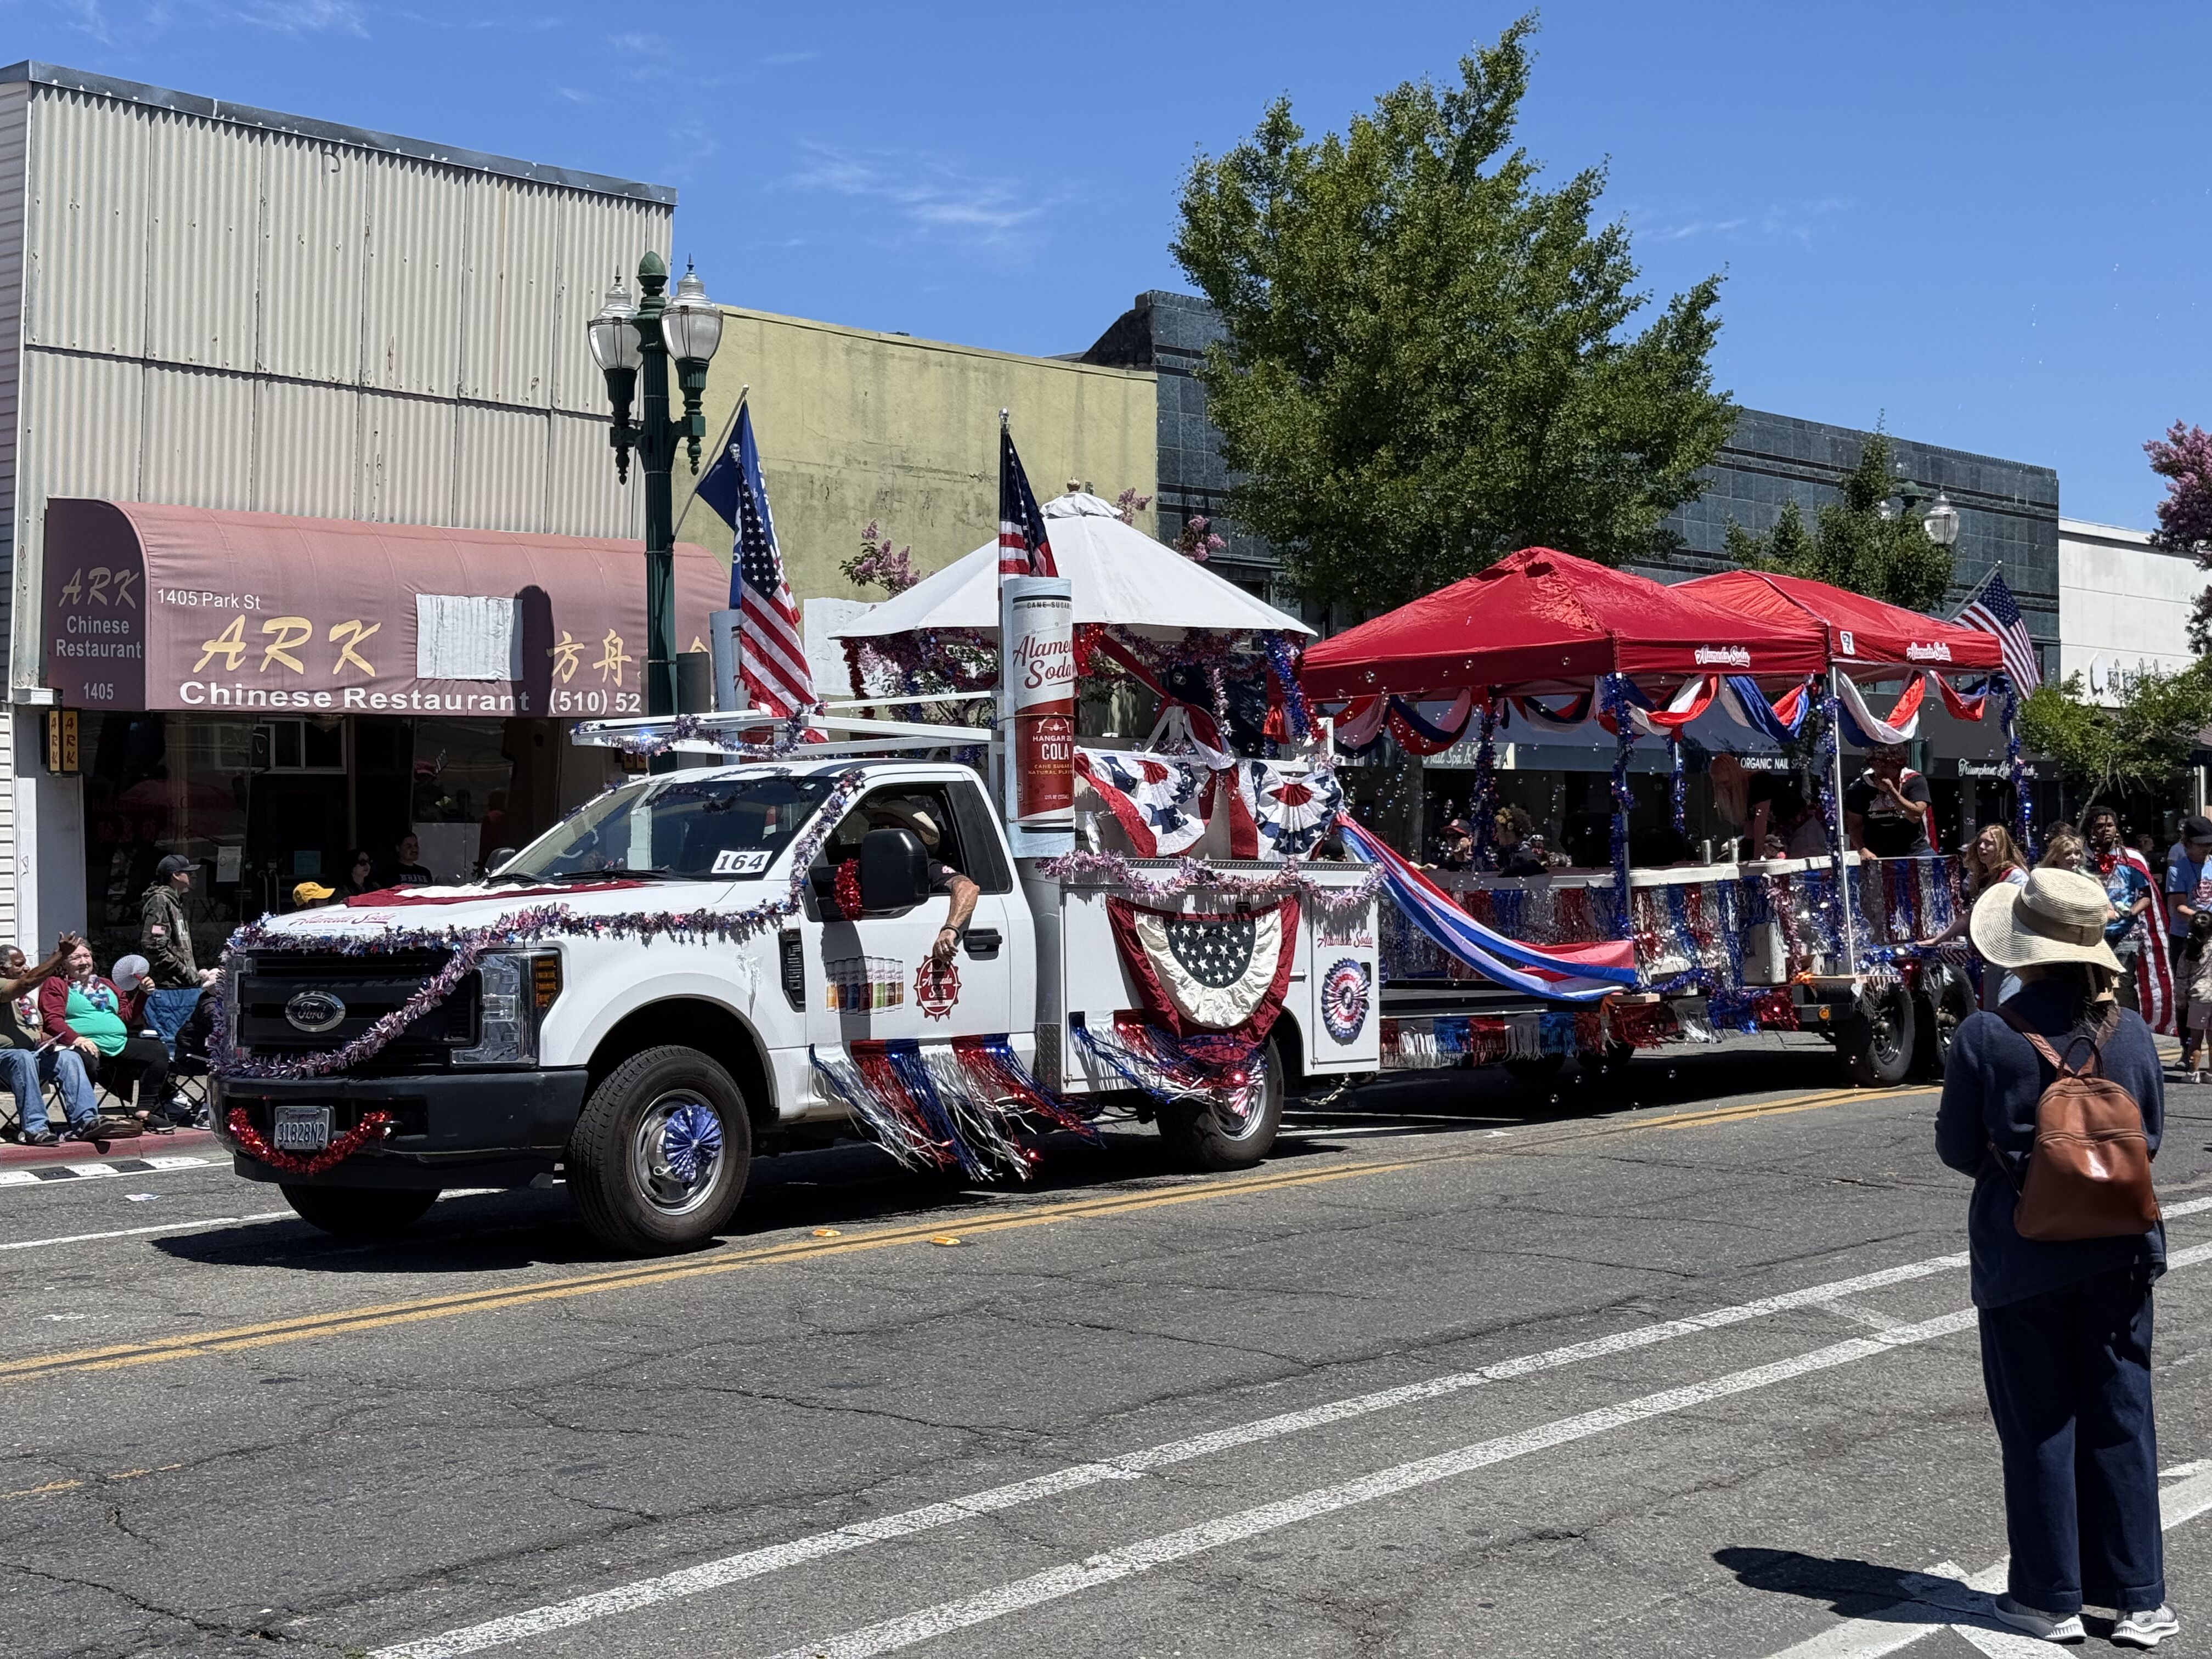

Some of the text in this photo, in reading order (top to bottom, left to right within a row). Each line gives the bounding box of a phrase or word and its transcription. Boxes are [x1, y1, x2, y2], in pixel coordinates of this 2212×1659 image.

[59, 566, 139, 610] ARK
[157, 588, 261, 611] 1405 Park St
[66, 615, 131, 635] Chinese
[56, 639, 142, 659] Restaurant
[1024, 656, 1073, 689] Soda
[83, 682, 115, 701] 1405
[179, 681, 332, 708] Chinese
[344, 687, 531, 712] Restaurant
[550, 687, 608, 715] (510)
[1041, 743, 1069, 760] COLA
[1740, 757, 1772, 769] ORGANIC
[1774, 757, 1789, 769] NAIL
[1958, 758, 1996, 778] Triumphant
[716, 854, 766, 870] 164
[1353, 931, 1374, 949] Soda
[297, 1001, 327, 1019] Ford
[278, 1122, 326, 1142] 31828N2
